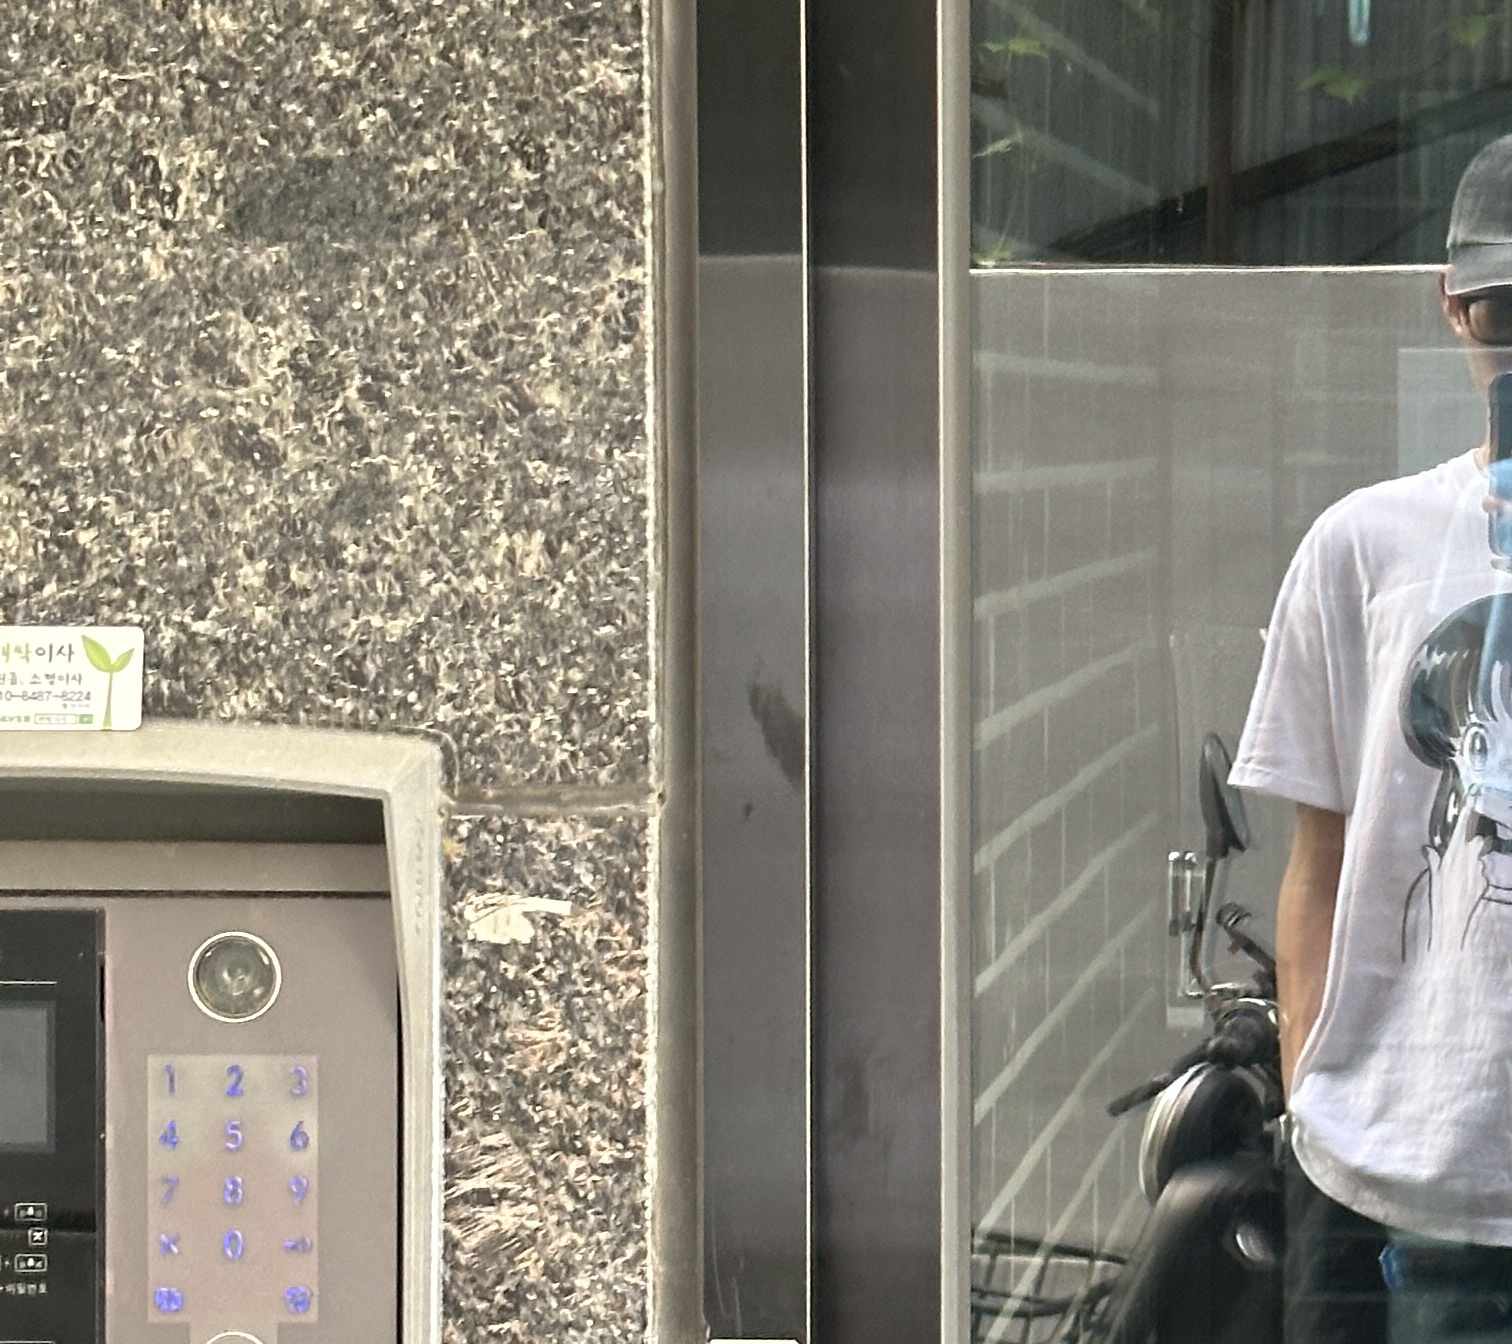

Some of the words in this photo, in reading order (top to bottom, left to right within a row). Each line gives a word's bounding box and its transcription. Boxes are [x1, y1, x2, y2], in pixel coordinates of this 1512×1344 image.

[166, 1064, 176, 1096] 1
[225, 1065, 243, 1097] 2
[291, 1066, 308, 1097] 3
[159, 1120, 178, 1149] 4
[225, 1120, 242, 1151] 5
[290, 1120, 309, 1152] 6
[161, 1174, 179, 1204] 7
[225, 1175, 243, 1205] 8
[289, 1175, 308, 1205] 9
[223, 1229, 244, 1260] 0
